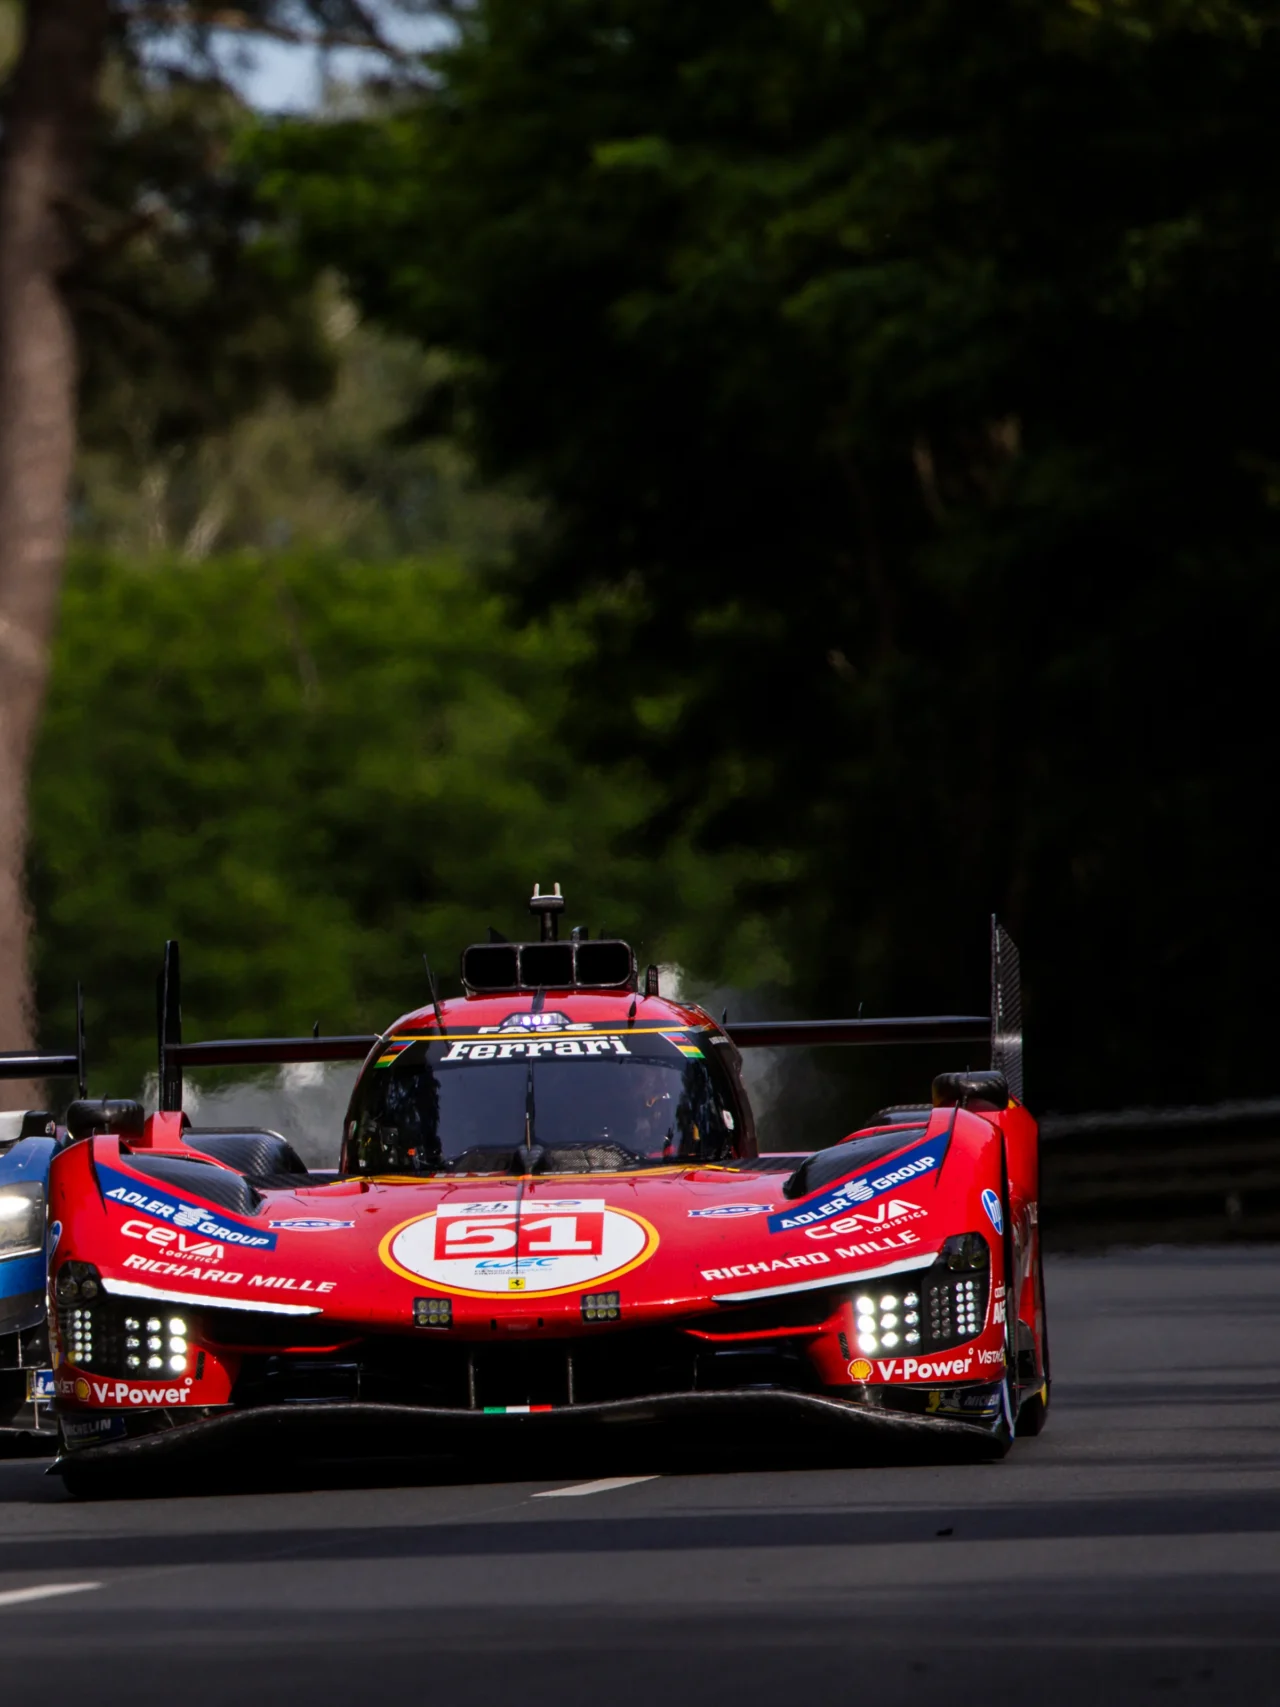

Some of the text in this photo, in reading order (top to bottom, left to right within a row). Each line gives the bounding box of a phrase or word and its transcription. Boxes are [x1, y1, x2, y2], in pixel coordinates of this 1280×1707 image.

[440, 1036, 631, 1061] Ferrari
[780, 1156, 936, 1229] ADLER GROUP
[105, 1187, 270, 1247] ADLER GROUP
[865, 1209, 928, 1234] LOGISTICS
[444, 1216, 592, 1254] 51
[159, 1248, 219, 1265] LOGISTICS
[700, 1230, 921, 1281] RICHARD MILLE
[122, 1254, 337, 1293] RICHARD MILLE
[877, 1357, 972, 1381] V-Power
[93, 1383, 190, 1404] V-Power
